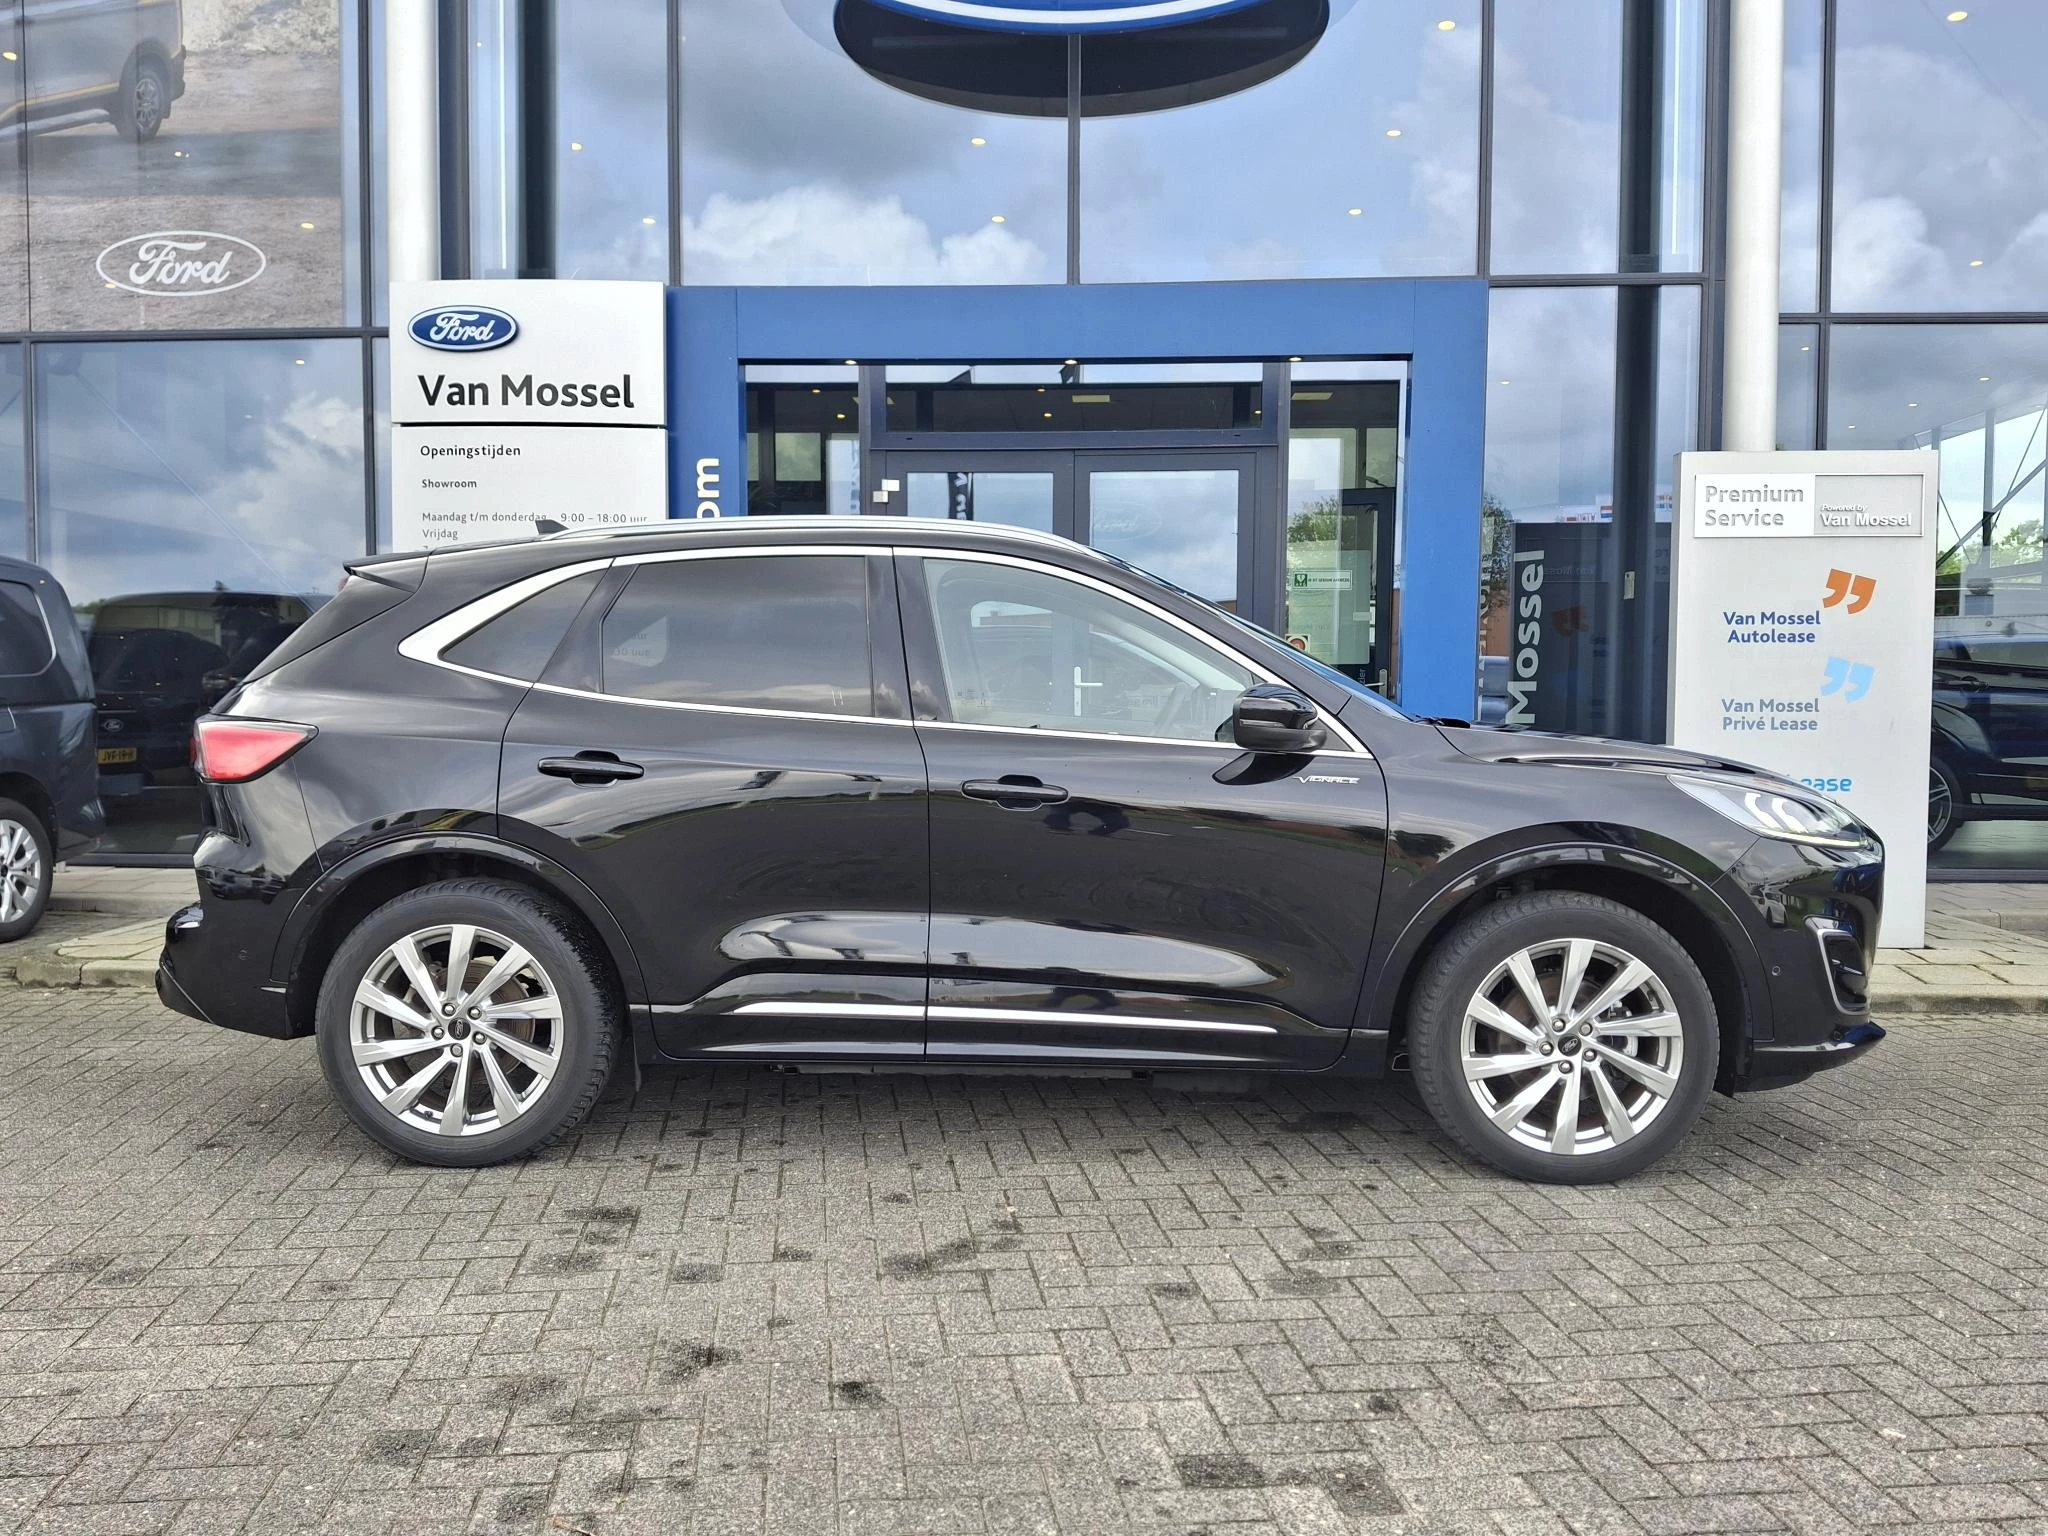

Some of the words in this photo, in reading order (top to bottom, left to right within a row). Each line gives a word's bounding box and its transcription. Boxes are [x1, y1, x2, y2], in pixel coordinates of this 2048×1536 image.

[129, 240, 233, 285] Ford
[430, 312, 496, 341] Ford
[417, 374, 490, 407] Van
[501, 374, 635, 408] Mossel
[420, 445, 521, 459] Openingstijden
[422, 479, 478, 489] Showroom
[1705, 484, 1804, 503] Premium
[1821, 503, 1856, 512] Powered
[1857, 504, 1868, 514] by
[422, 512, 467, 524] Maandag
[469, 512, 489, 523] t/m
[560, 513, 585, 523] 9:00
[597, 513, 627, 523] 18:00
[1705, 508, 1784, 527] Service
[1820, 512, 1851, 527] Van
[1855, 512, 1912, 527] Mossel
[422, 528, 459, 540] Vrijdag
[1723, 611, 1756, 626] Van
[1760, 610, 1821, 626] Mossel
[1505, 550, 1545, 724] Mossel
[1727, 628, 1816, 643] Autolease
[1721, 698, 1754, 713] Van
[1759, 698, 1820, 713] Mossel
[1722, 716, 1766, 731] Privé
[1770, 716, 1818, 731] Lease
